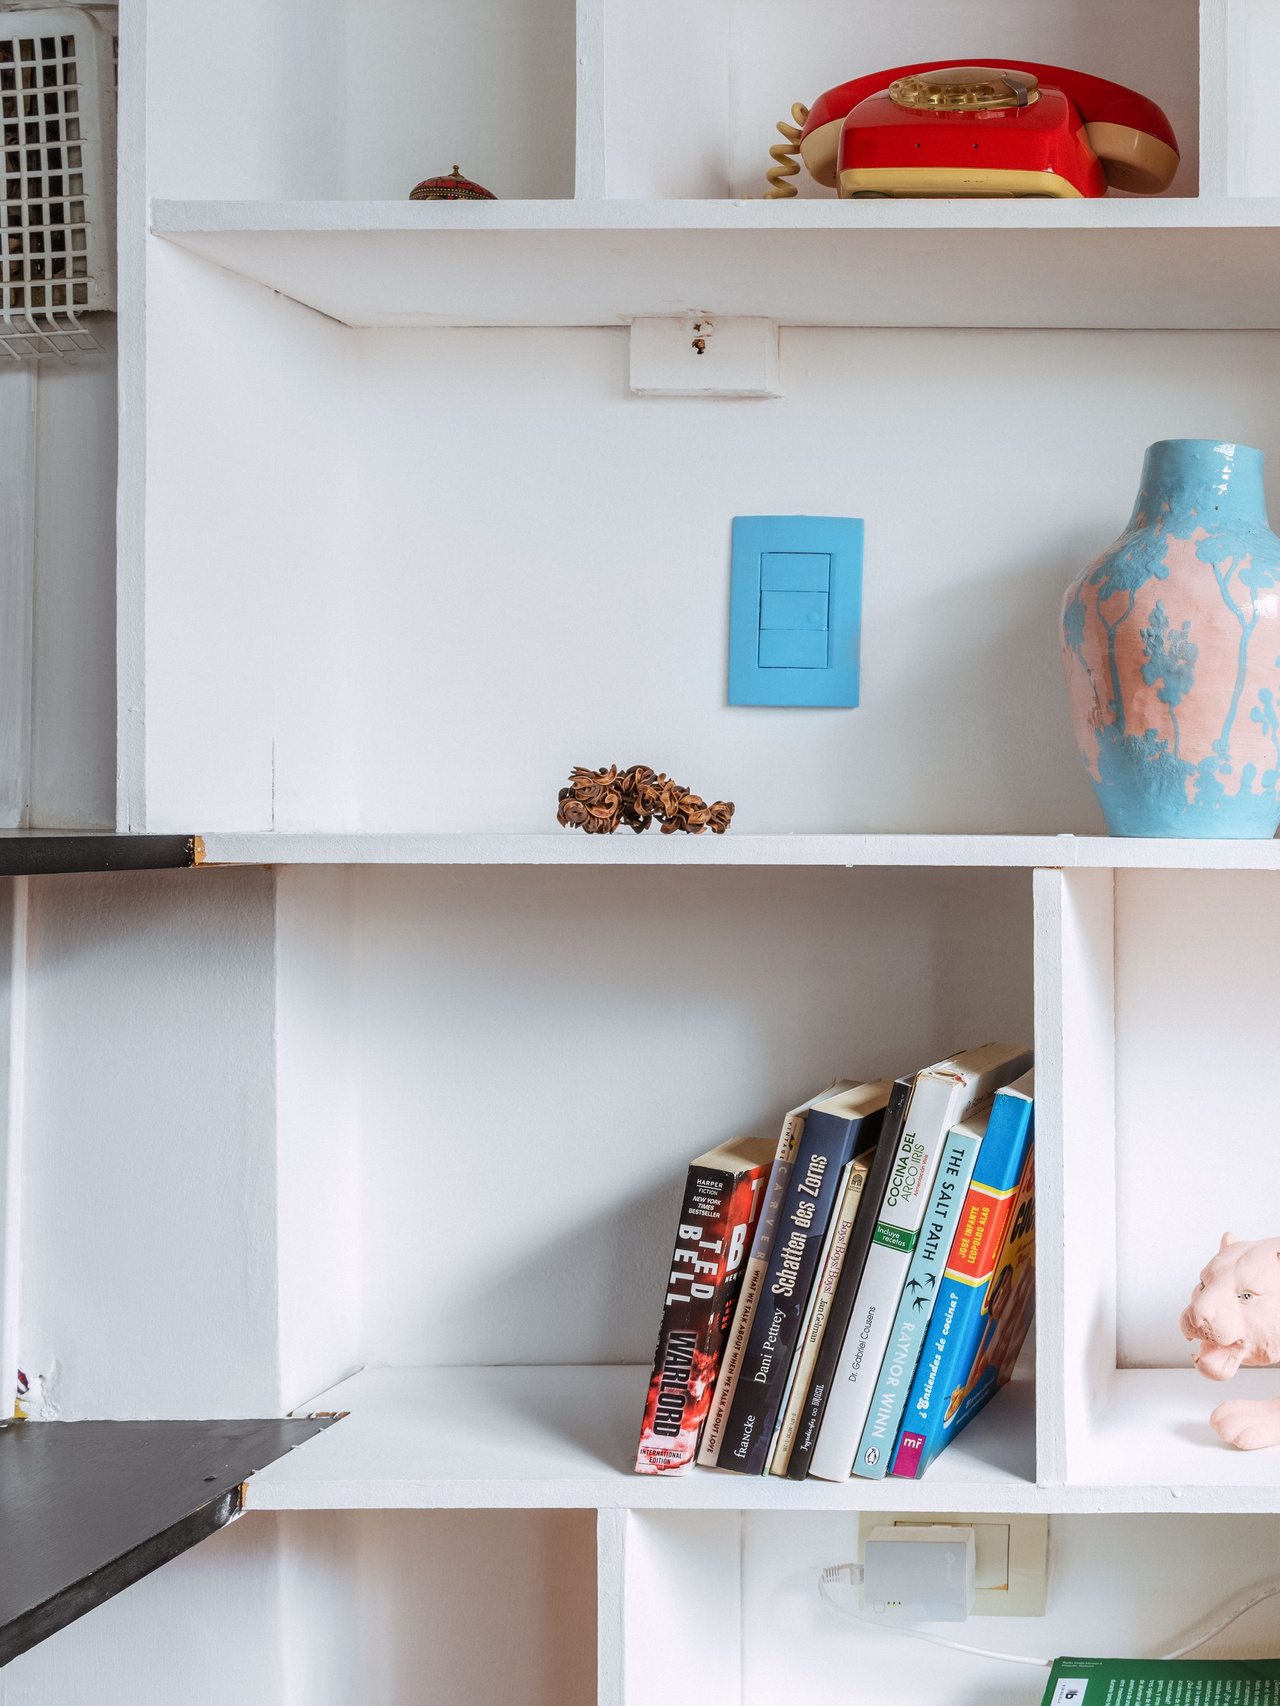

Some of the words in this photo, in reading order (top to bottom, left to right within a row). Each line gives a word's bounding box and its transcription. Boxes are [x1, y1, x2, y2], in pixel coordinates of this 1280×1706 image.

[779, 1122, 793, 1160] VINTAGE
[797, 1154, 828, 1197] Zorns
[887, 1155, 909, 1207] COCINA
[902, 1132, 917, 1154] DEL
[900, 1166, 918, 1203] ARCO
[912, 1144, 925, 1166] IRIS
[948, 1149, 965, 1177] THE
[696, 1179, 723, 1189] HARPER
[698, 1188, 718, 1196] FICTION
[913, 1165, 925, 1197] Alimentación
[688, 1208, 721, 1218] BESTSELLER
[692, 1195, 707, 1203] NEW
[706, 1198, 722, 1206] YORK
[698, 1203, 715, 1211] TIMES
[756, 1166, 787, 1259] CARVER
[934, 1181, 955, 1219] SALT
[790, 1200, 816, 1229] des
[837, 1220, 852, 1246] Boys!
[877, 1226, 900, 1239] Incluye
[882, 1234, 906, 1247] recetas
[921, 1222, 944, 1261] PATH
[958, 1235, 971, 1259] JOSÉ
[965, 1206, 980, 1233] INFANTE
[967, 1226, 985, 1264] LEOPOLDO
[978, 1206, 991, 1226] ALAS
[665, 1223, 704, 1306] BELL
[690, 1240, 723, 1299] TED
[771, 1231, 808, 1297] Schatten
[830, 1245, 846, 1270] Boys!
[748, 1270, 761, 1294] WHAT
[823, 1268, 841, 1295] Boys!
[747, 1295, 755, 1305] WE
[818, 1298, 828, 1313] Jan
[742, 1306, 752, 1324] TALK
[860, 1305, 877, 1339] Cousens
[734, 1325, 745, 1351] ABOUT
[762, 1308, 787, 1351] Pettrey
[729, 1352, 739, 1374] WHEN
[754, 1351, 773, 1384] Dani
[851, 1339, 867, 1370] Gabriel
[886, 1321, 916, 1388] RAYNOR
[916, 1353, 942, 1419] ¿Entiendes
[935, 1338, 946, 1352] de
[942, 1292, 959, 1336] cocina?
[653, 1332, 698, 1437] WARLORD
[725, 1376, 734, 1387] WE
[848, 1372, 858, 1383] Dr.
[719, 1388, 731, 1407] TALK
[714, 1408, 725, 1434] ABOUT
[872, 1394, 897, 1439] WINN
[640, 1449, 683, 1459] INTERNATIONAL
[707, 1435, 718, 1454] LOVE
[649, 1457, 671, 1465] EDITION
